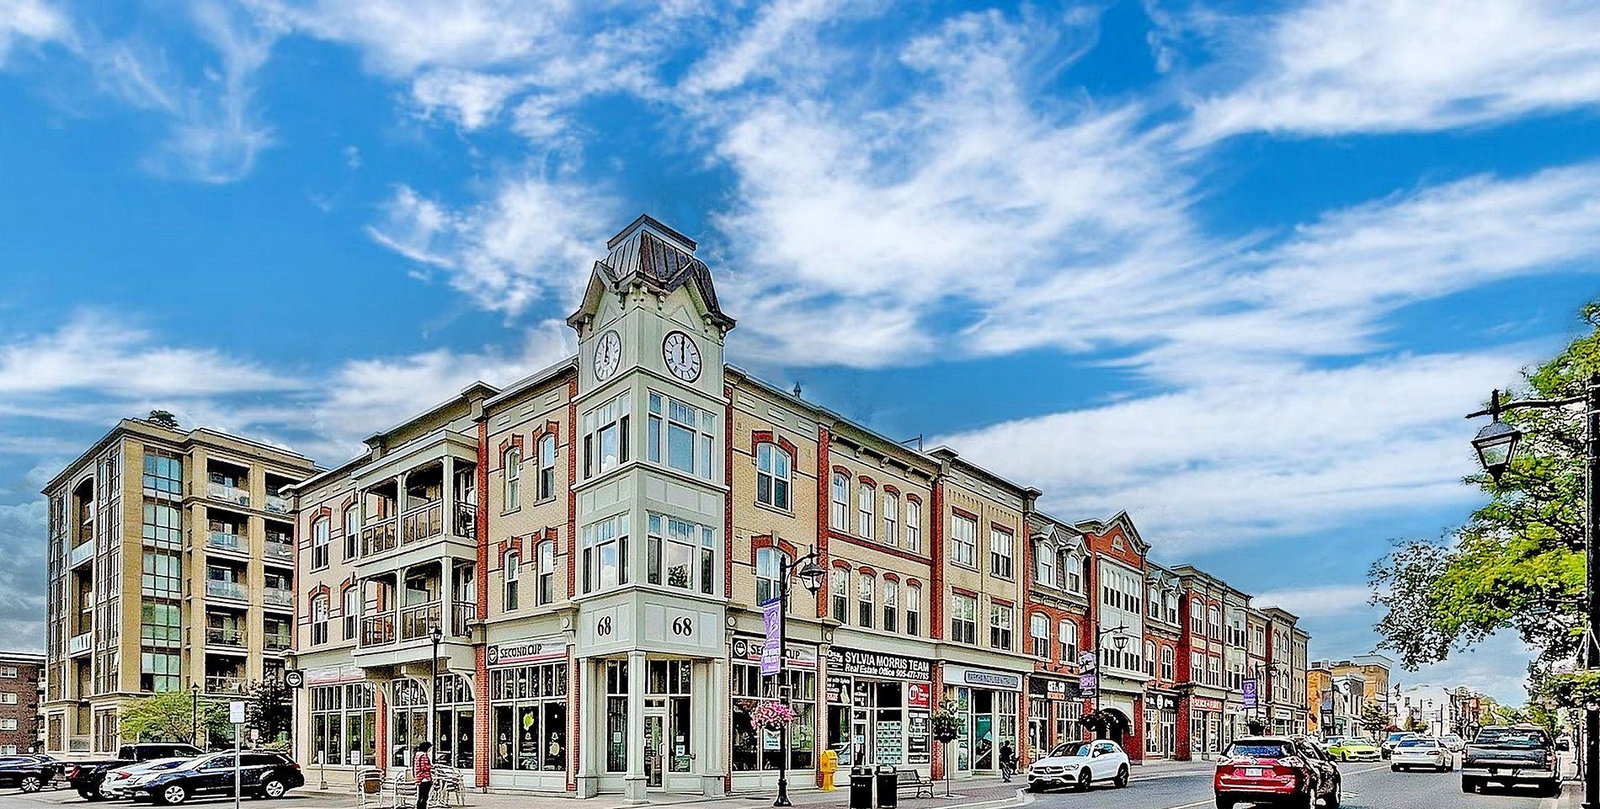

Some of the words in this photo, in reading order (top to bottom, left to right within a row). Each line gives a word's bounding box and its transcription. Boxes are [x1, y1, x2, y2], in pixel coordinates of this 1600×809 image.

[598, 616, 612, 636] 68
[672, 616, 692, 636] 68
[500, 646, 527, 658] SECOND
[528, 644, 542, 654] CUP
[785, 648, 800, 660] CUP
[844, 651, 875, 666] SYLVIA
[876, 655, 908, 670] MORRIS
[908, 660, 930, 672] TEAM
[844, 663, 860, 672] Real
[860, 665, 878, 675] Estate
[878, 668, 895, 677] Office
